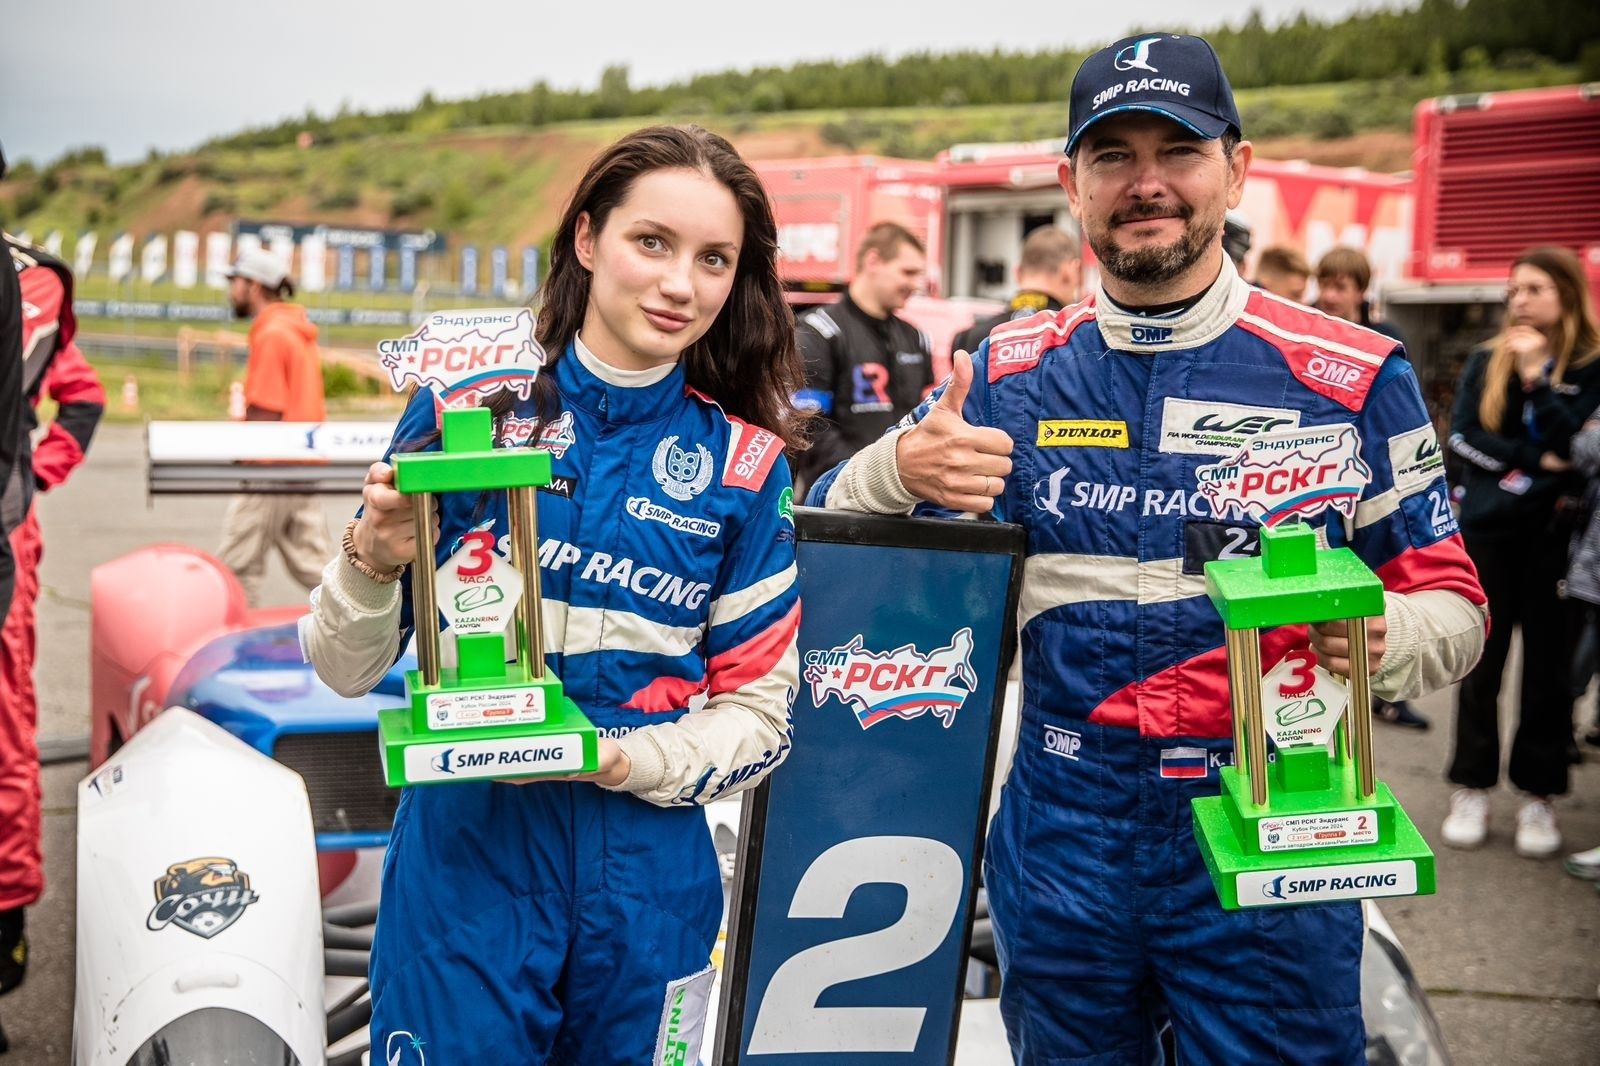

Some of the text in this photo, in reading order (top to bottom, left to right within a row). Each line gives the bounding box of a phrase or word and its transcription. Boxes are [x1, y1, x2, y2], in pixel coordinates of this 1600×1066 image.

[1092, 78, 1191, 110] SMP RACING
[432, 315, 512, 327] Эндуранс
[1131, 327, 1173, 342] OMP
[379, 340, 419, 353] СМП
[997, 339, 1043, 361] OMP
[420, 344, 514, 373] РСКГ
[1306, 357, 1361, 386] OMP
[502, 423, 560, 439] РСГ
[1056, 427, 1122, 439] DUNLOP
[1252, 435, 1335, 451] Эндуранс
[1198, 466, 1239, 482] СМП
[1240, 463, 1338, 498] РСКГ
[1070, 481, 1137, 512] SMP
[645, 504, 719, 536] SMP RACING
[457, 531, 496, 576] 3
[1217, 527, 1257, 560] 2
[459, 575, 494, 584] ЧАСА
[580, 551, 712, 610] RACING
[804, 650, 849, 666] СМП
[843, 662, 947, 692] РСКГ
[1279, 650, 1318, 695] 3
[525, 693, 535, 708] 2
[1044, 730, 1081, 755] OMP
[1276, 727, 1322, 737] KAZANRING
[456, 747, 564, 768] SMP RACING
[1319, 816, 1349, 825] Эндуранс
[1357, 815, 1368, 830] 2
[1287, 873, 1397, 894] SMP RACING
[146, 888, 260, 932] Сочи
[747, 835, 964, 1056] 2
